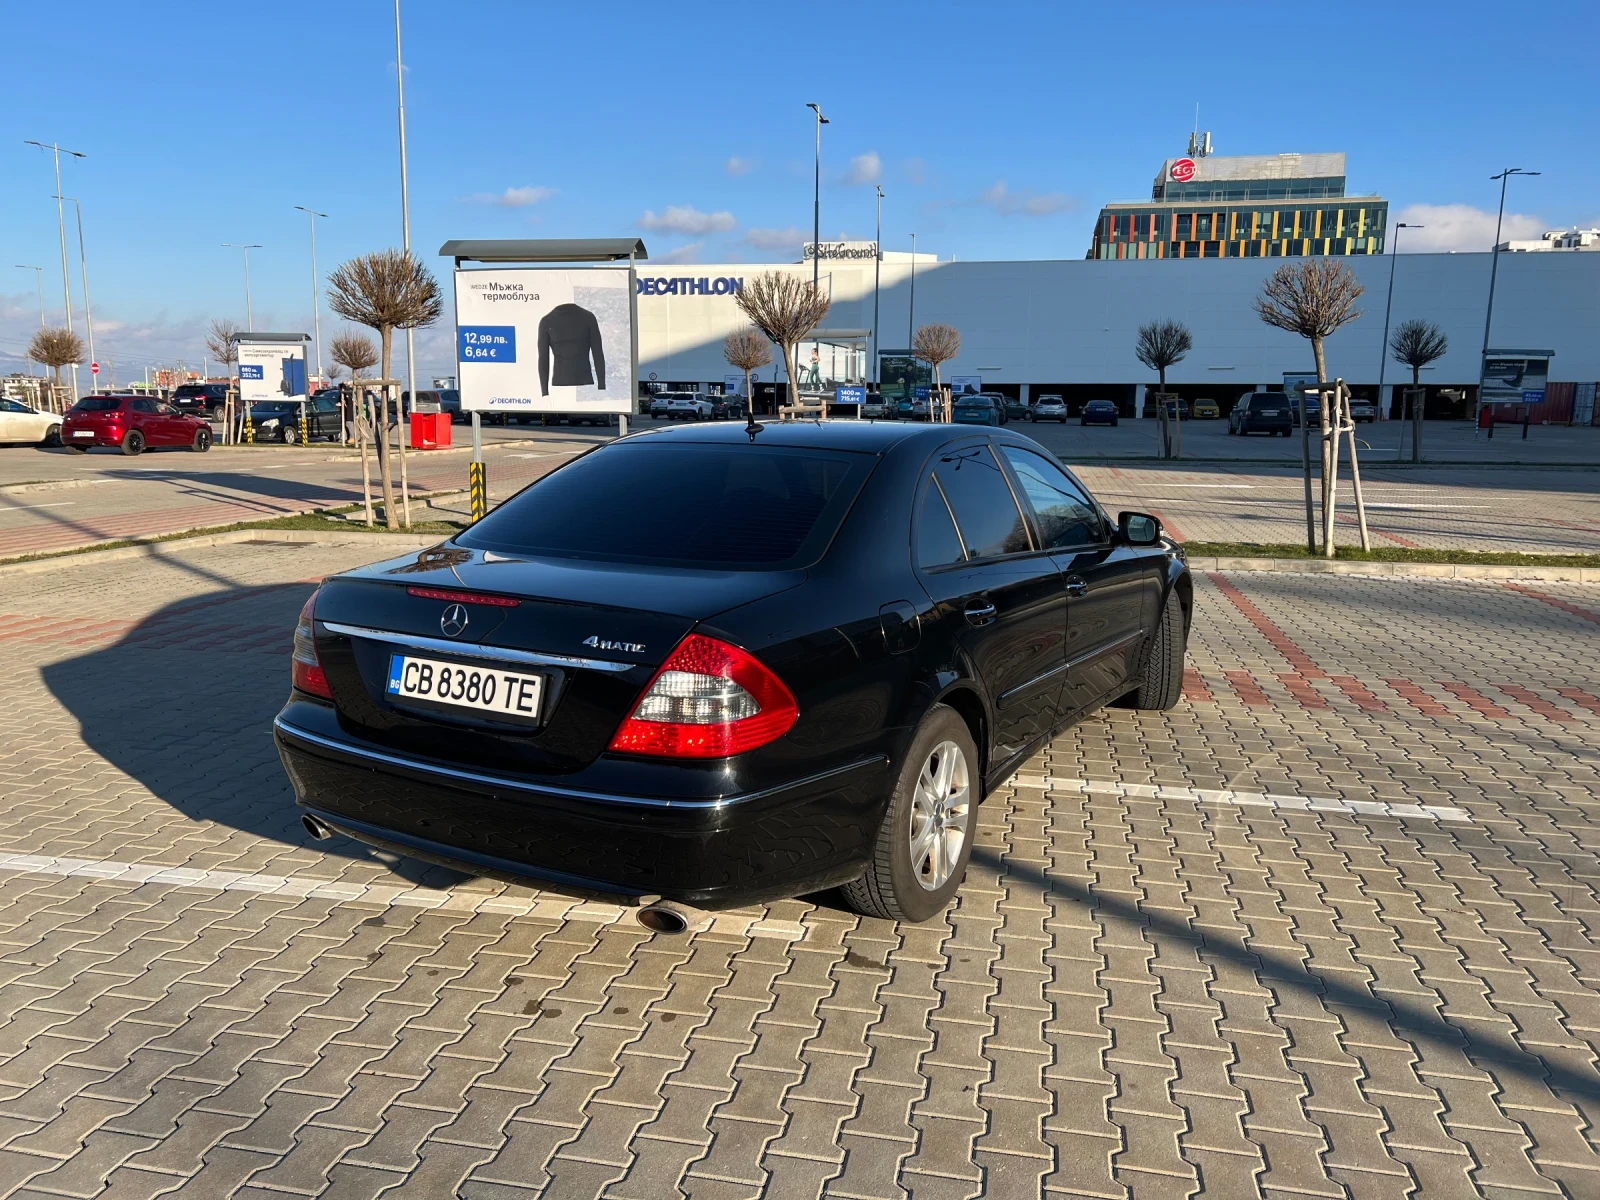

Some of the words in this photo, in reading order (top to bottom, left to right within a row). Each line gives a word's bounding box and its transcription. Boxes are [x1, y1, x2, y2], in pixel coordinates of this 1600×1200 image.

[816, 243, 877, 259] SiteGround
[489, 282, 524, 291] Мъжка
[482, 292, 540, 303] термоблуза
[464, 332, 492, 345] 12,99
[493, 336, 508, 344] лв.
[465, 346, 488, 359] 6,64
[490, 348, 497, 357] €
[582, 635, 646, 652] 4MATIC
[390, 679, 400, 689] BG
[403, 662, 434, 695] CB
[437, 667, 497, 705] 8380
[504, 676, 536, 712] TE
